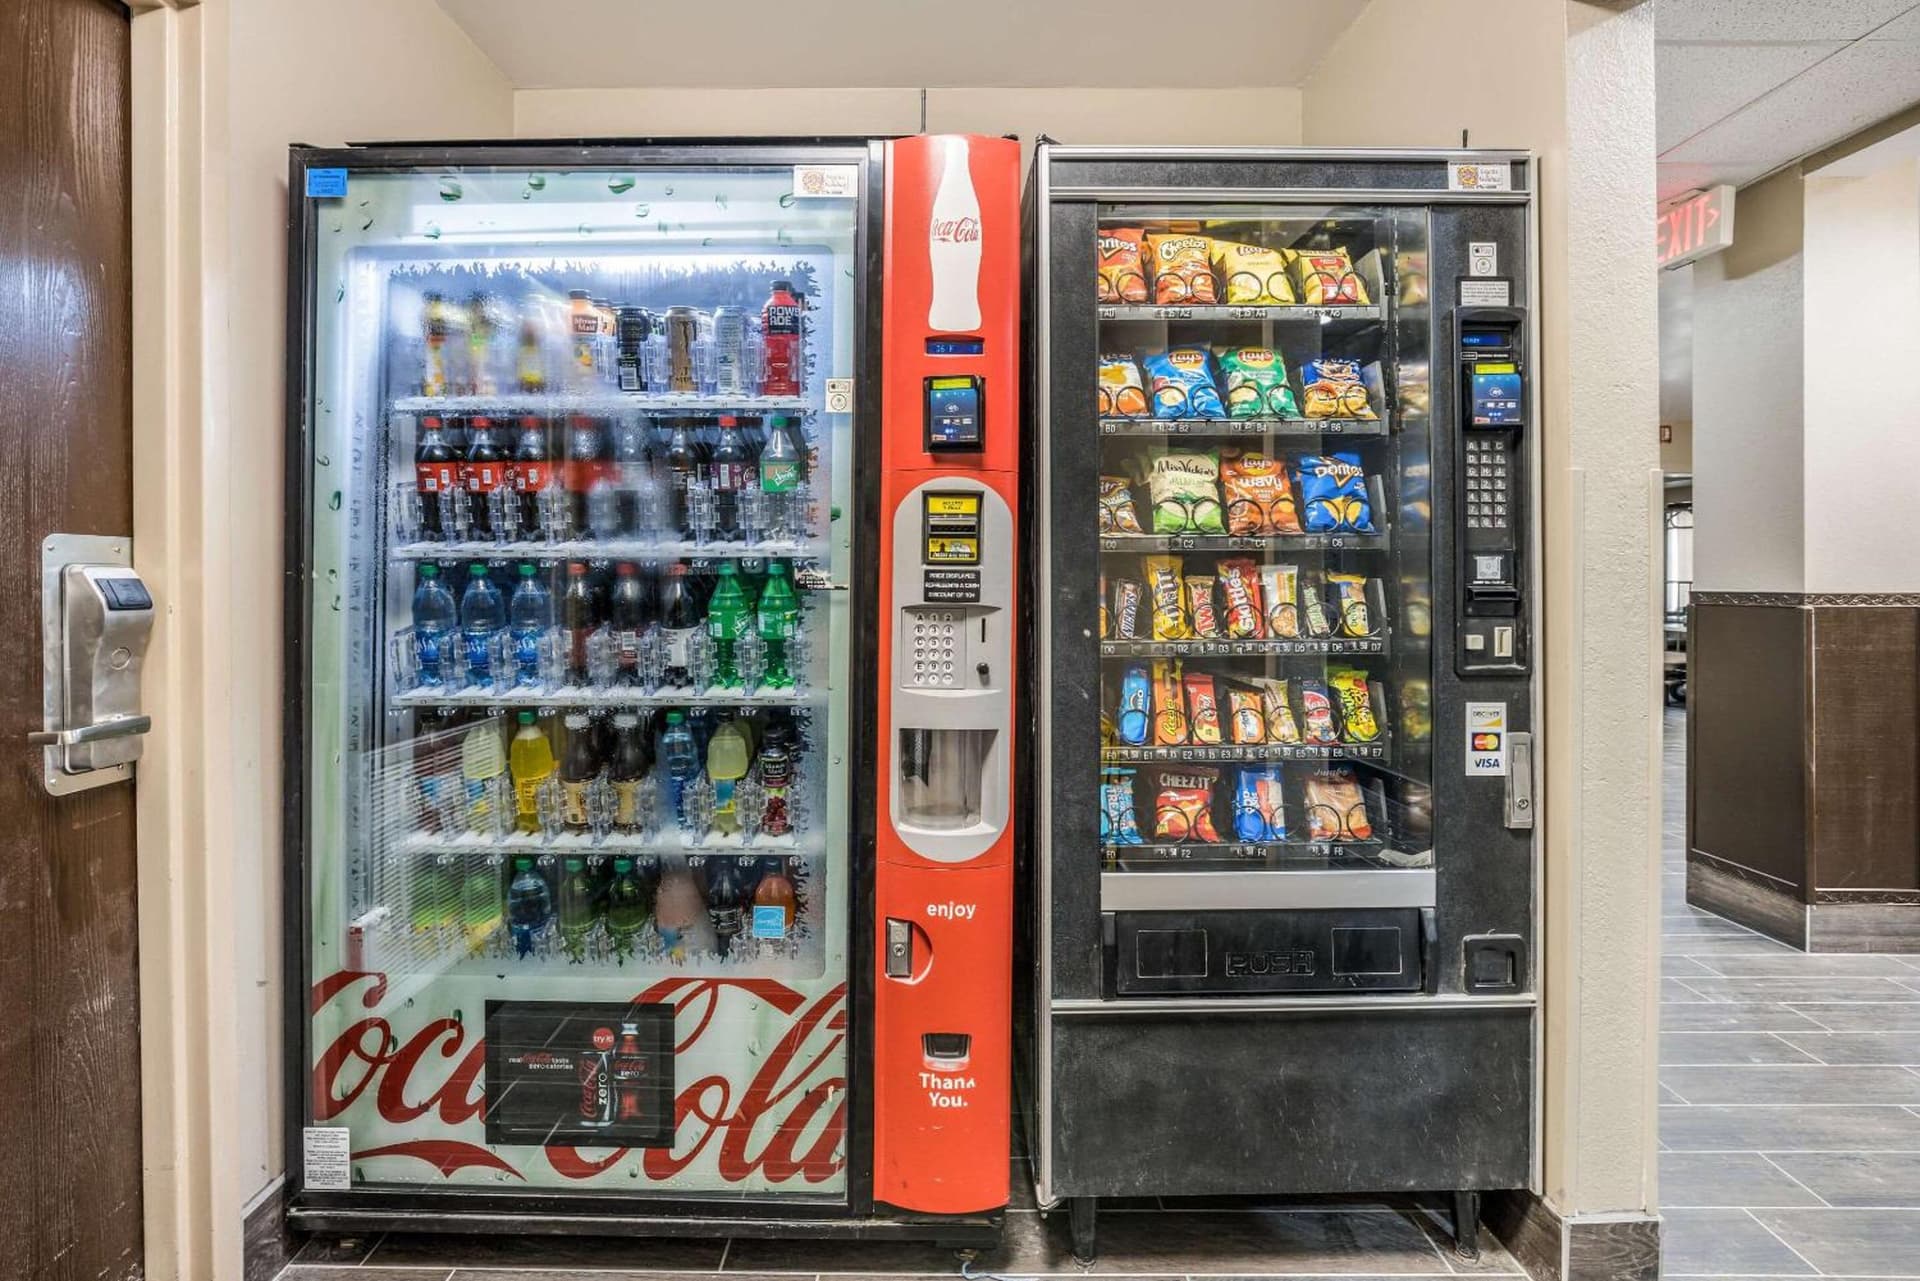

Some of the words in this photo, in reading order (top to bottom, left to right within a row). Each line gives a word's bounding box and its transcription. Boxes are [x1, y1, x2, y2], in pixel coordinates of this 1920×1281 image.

[932, 216, 979, 243] oca-Cola
[1098, 237, 1137, 252] oritos
[1161, 238, 1208, 261] Cheetos
[769, 306, 800, 317] POWE
[1172, 352, 1203, 364] Lay's
[1242, 351, 1272, 361] Lay's
[1239, 475, 1283, 490] wavy
[1182, 750, 1193, 759] E2
[1474, 758, 1500, 768] VISA
[1181, 849, 1192, 858] F2
[927, 902, 977, 919] enjoy
[1227, 951, 1313, 976] PUSH
[599, 1072, 608, 1105] zero
[929, 1092, 968, 1108] You.
